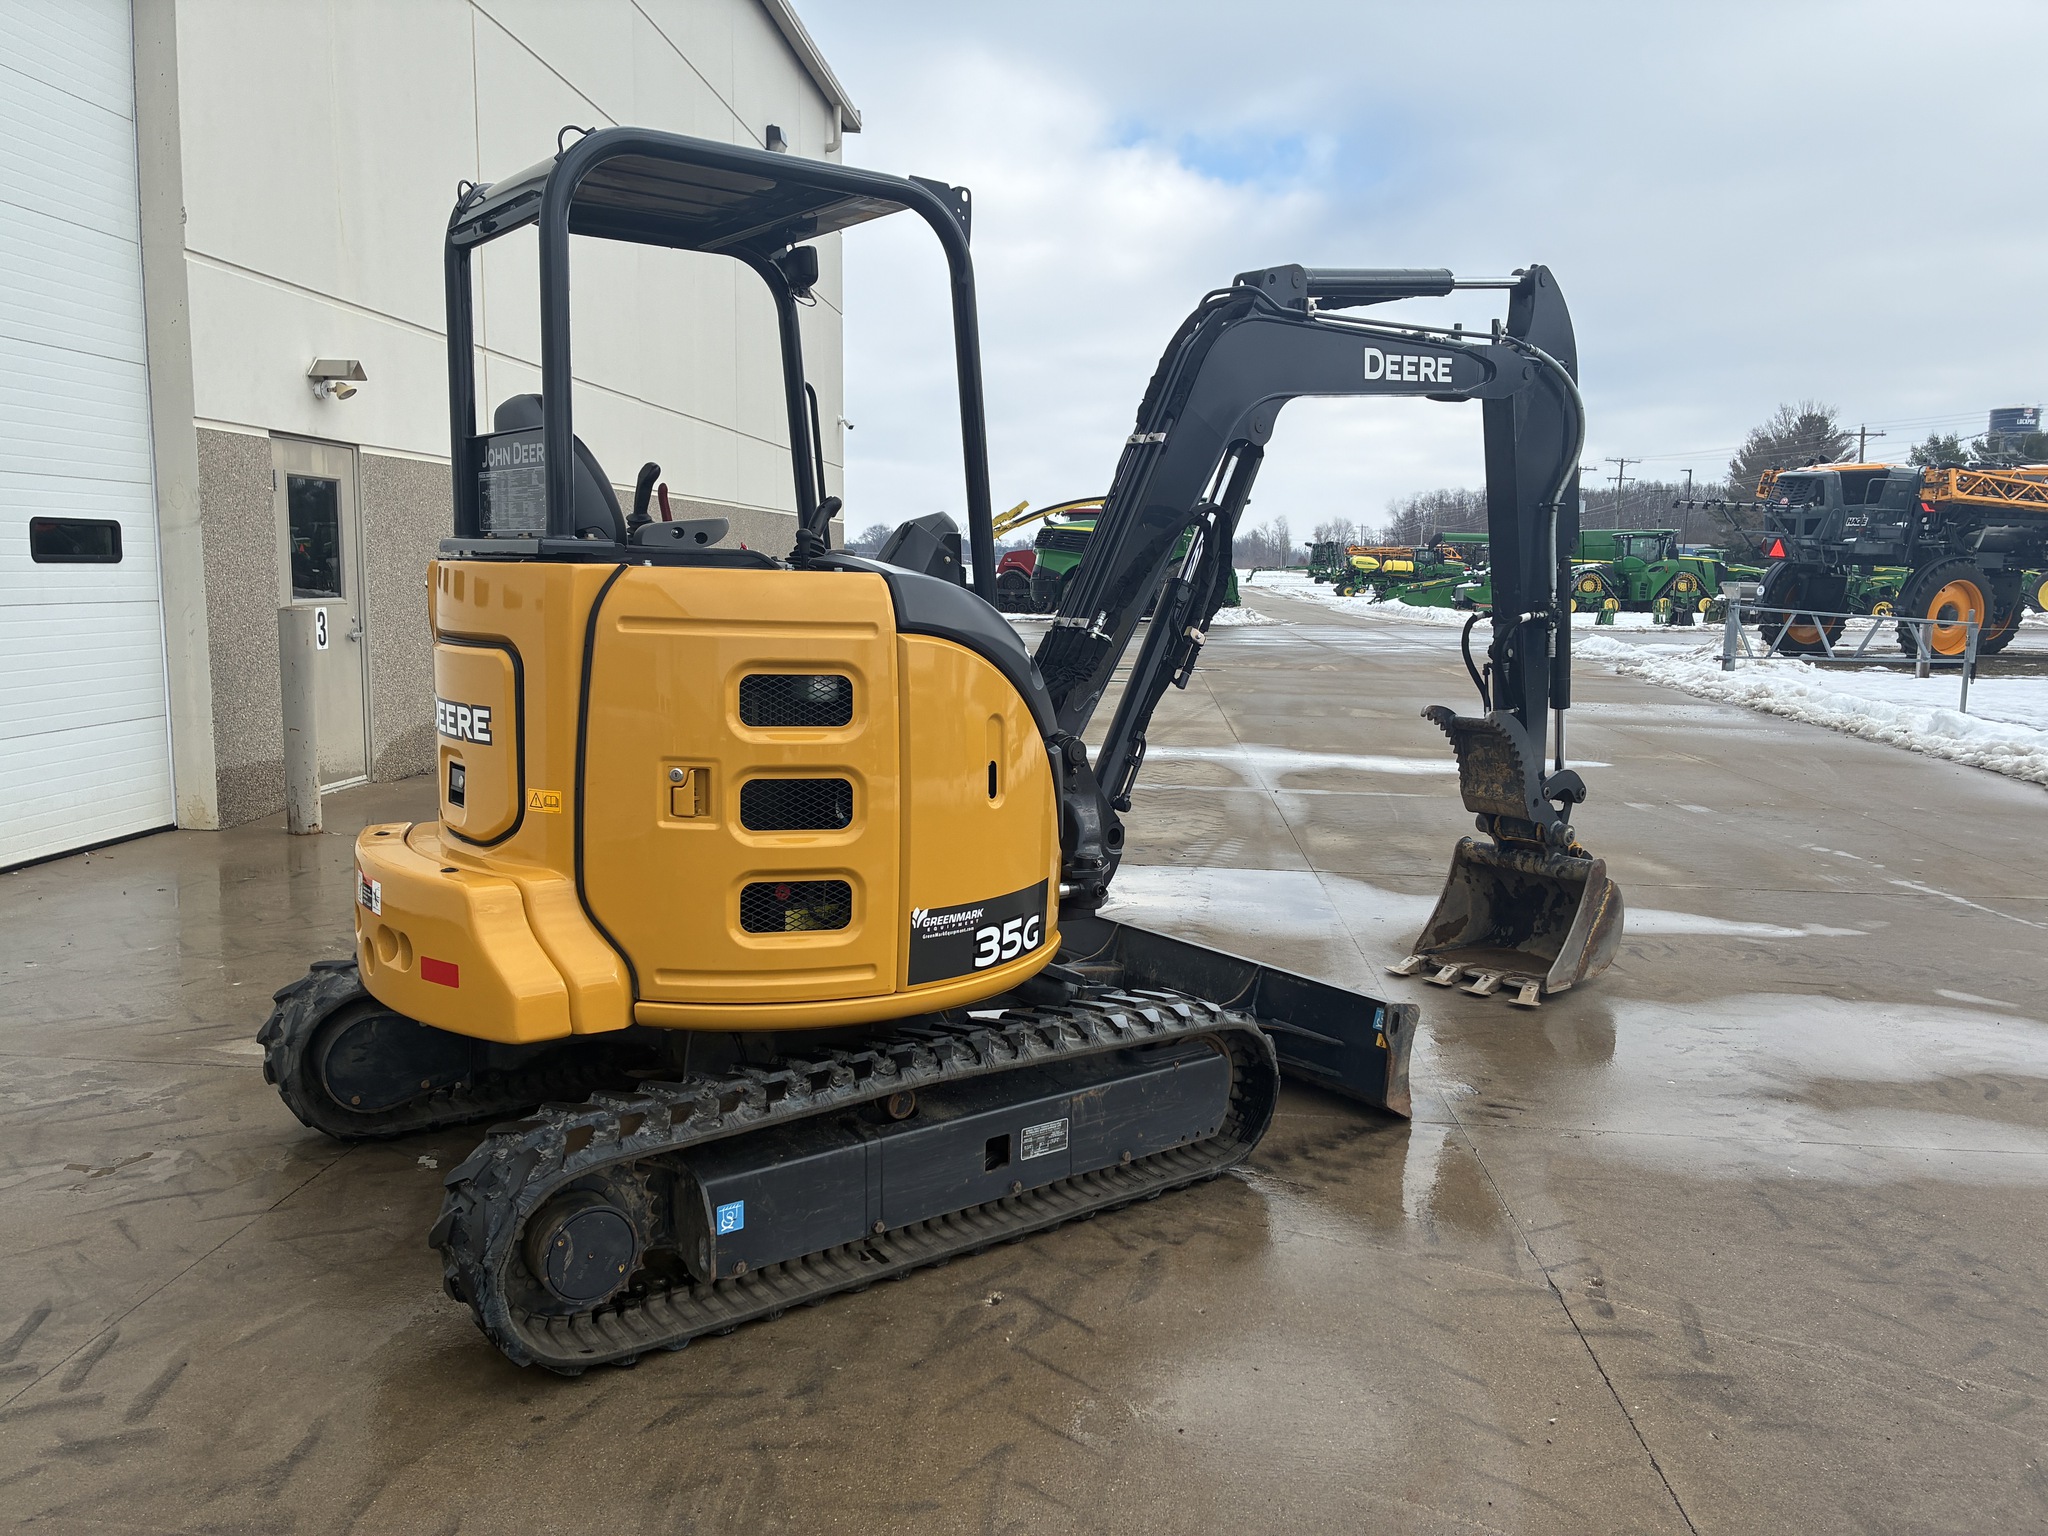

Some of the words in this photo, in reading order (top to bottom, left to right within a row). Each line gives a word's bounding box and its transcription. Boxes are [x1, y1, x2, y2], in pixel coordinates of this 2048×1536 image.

[1364, 347, 1453, 383] DEERE
[482, 445, 511, 468] JOHN
[513, 441, 545, 465] DEER
[317, 611, 327, 646] 3
[436, 697, 491, 742] EERE
[922, 908, 985, 928] GREENMARK
[926, 919, 980, 932] EQUIPMENT
[974, 914, 1039, 968] 35G
